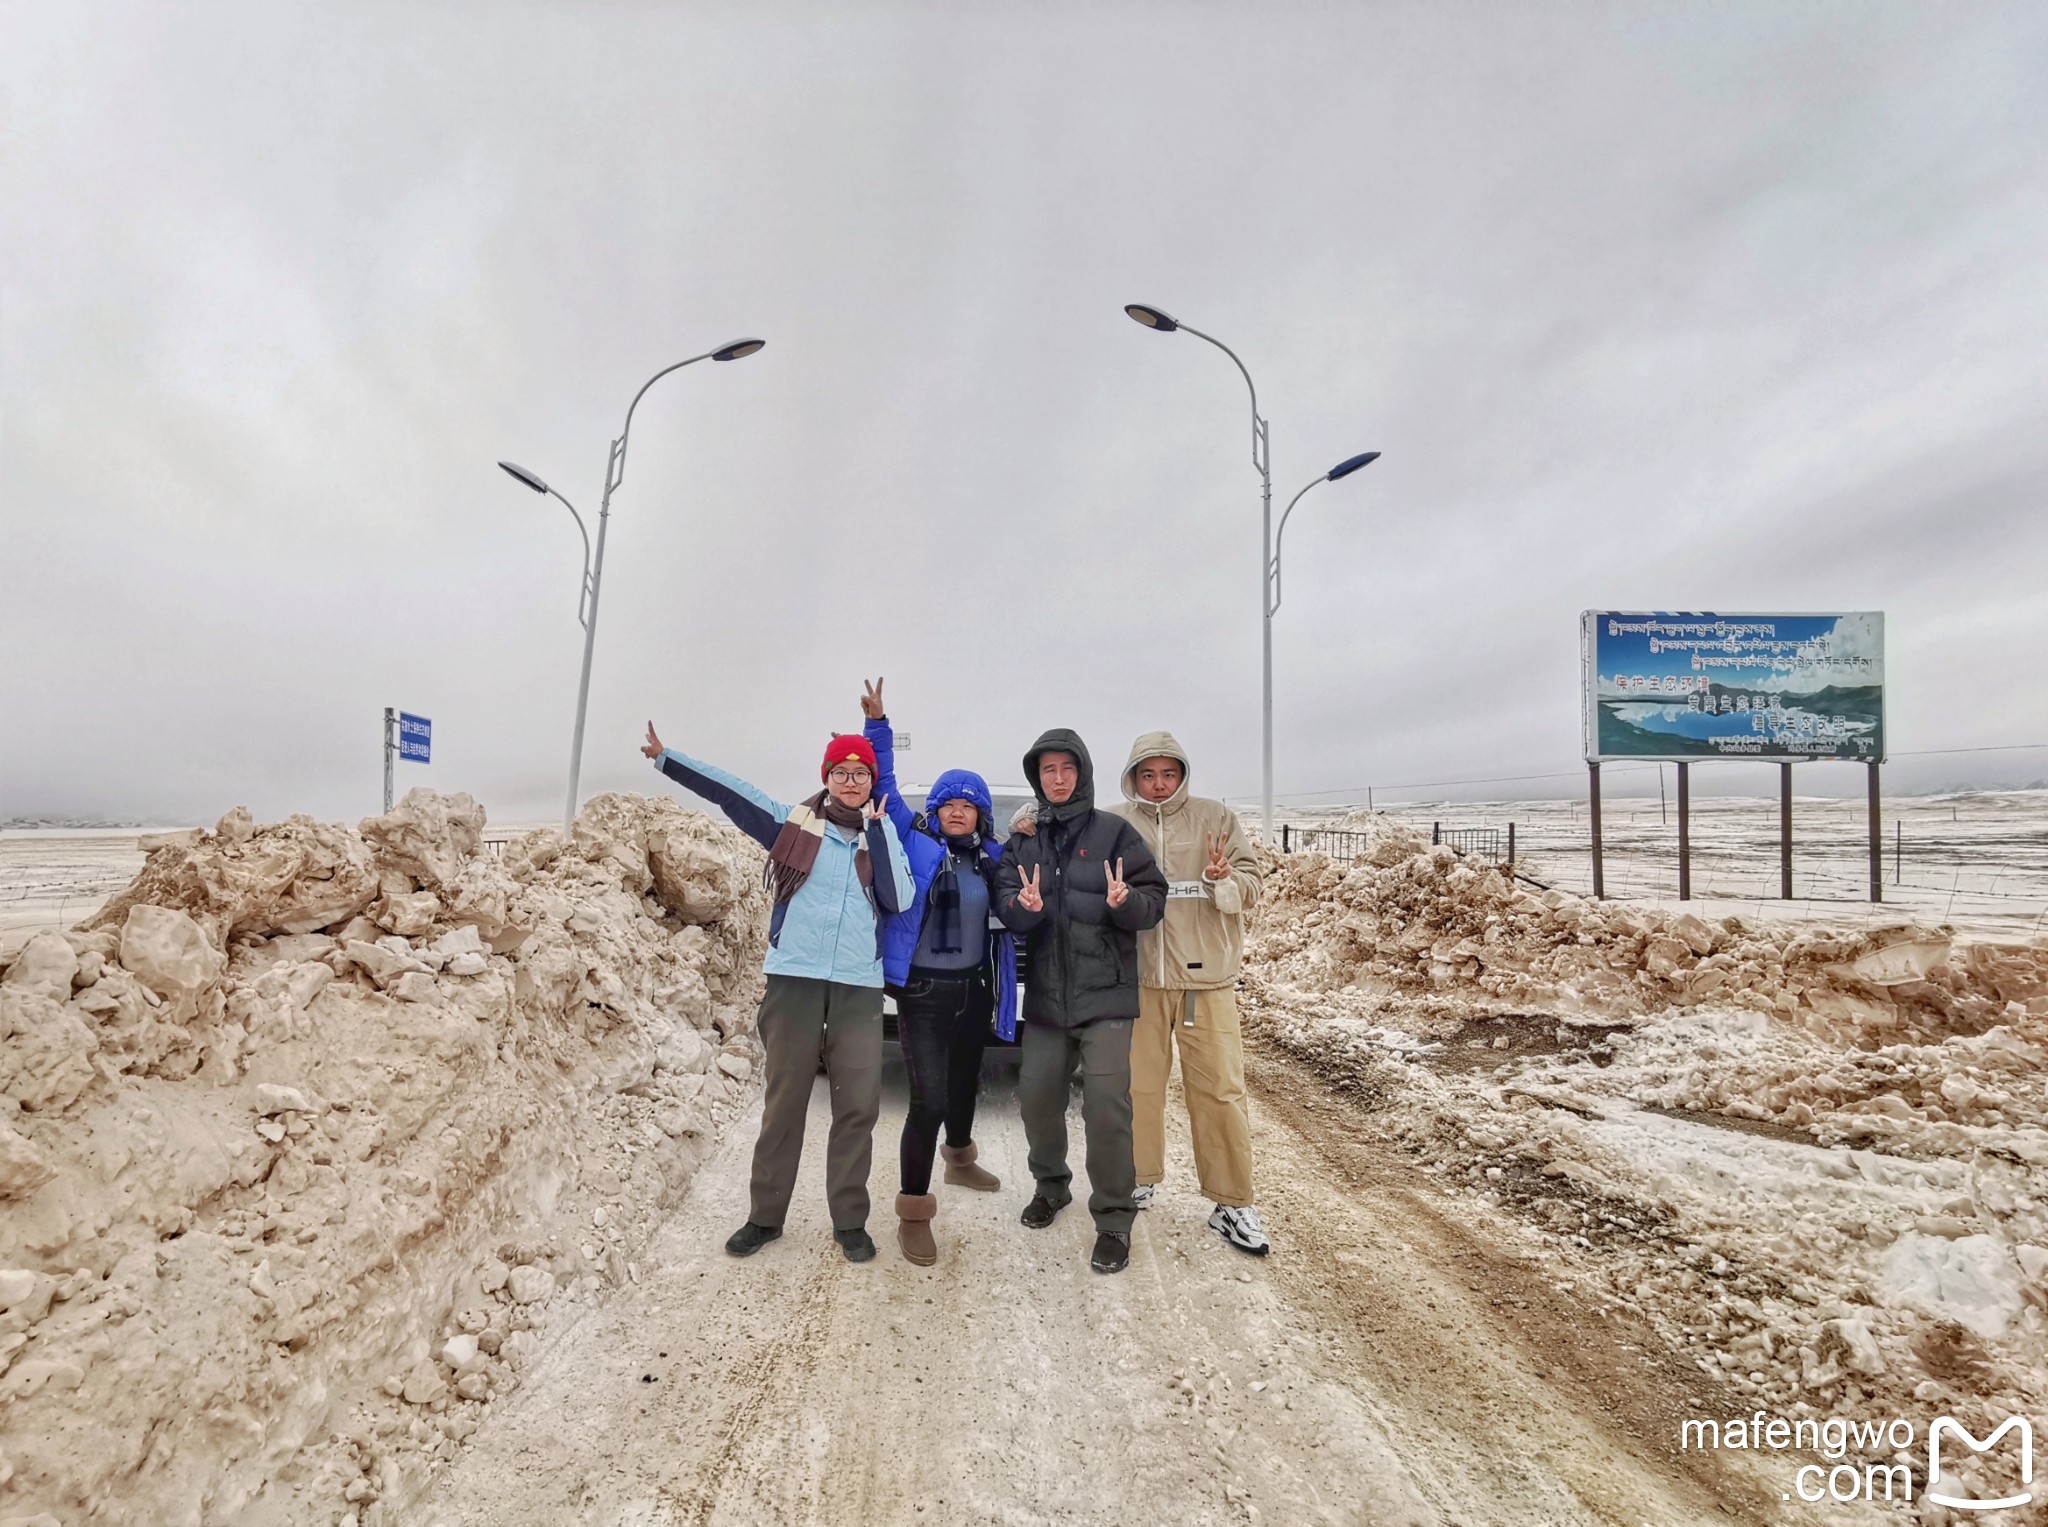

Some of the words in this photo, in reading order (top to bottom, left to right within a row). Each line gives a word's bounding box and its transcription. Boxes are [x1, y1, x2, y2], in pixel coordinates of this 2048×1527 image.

[1616, 676, 1711, 693] 保护生态环境
[1688, 695, 1781, 713] 发展生态经济
[1753, 715, 1846, 732] 倡导生态文明
